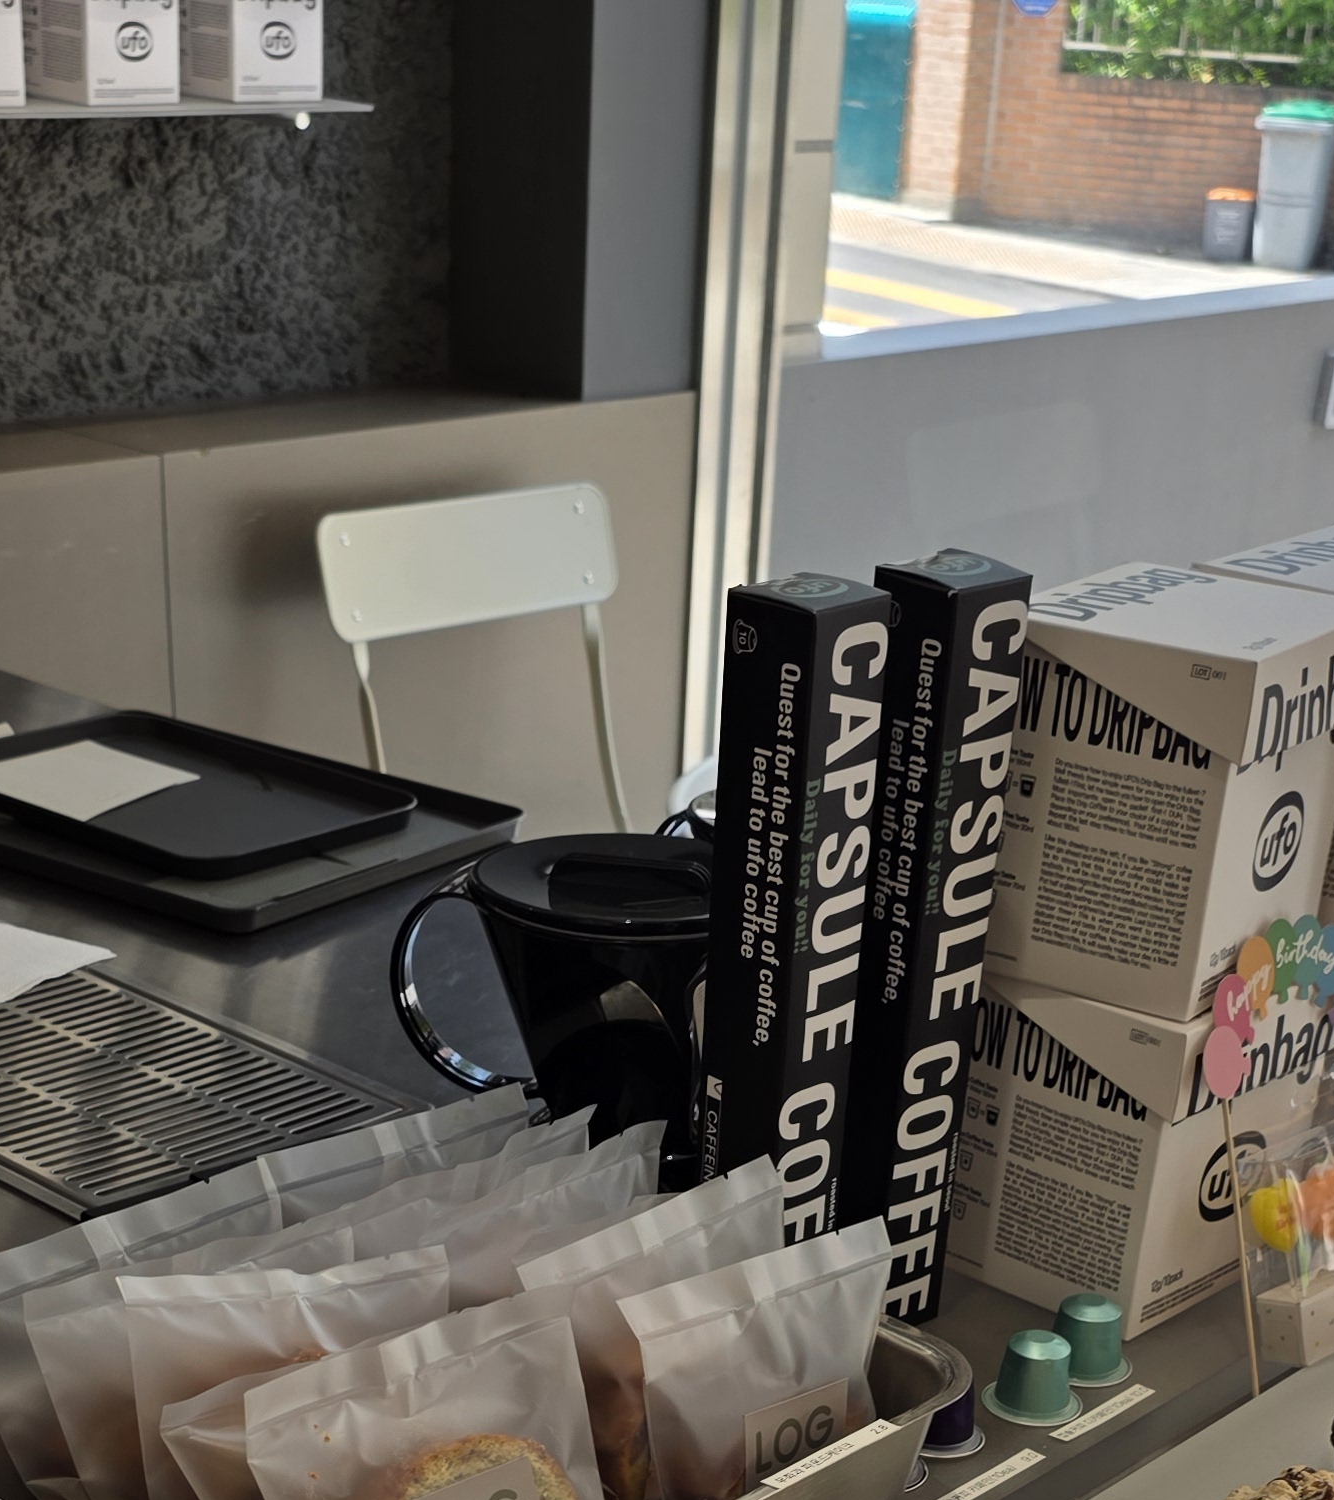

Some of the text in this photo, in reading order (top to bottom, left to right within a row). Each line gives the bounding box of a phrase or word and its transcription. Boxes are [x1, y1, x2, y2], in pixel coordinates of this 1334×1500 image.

[122, 33, 149, 52] ufo
[265, 32, 291, 51] ufo
[916, 638, 942, 711] Quest
[1052, 662, 1088, 742] TO
[912, 715, 933, 749] for
[907, 751, 928, 793] the
[873, 719, 909, 920] lead to ufo coffee
[902, 798, 924, 851] best
[930, 599, 1028, 1020] CAPSULE
[1260, 811, 1297, 864] ufo
[740, 747, 772, 960] lead to ufo coffee
[753, 662, 801, 1047] Quest for the best cup of coffee,
[894, 854, 913, 898] cup
[777, 620, 889, 1243] CAPSULE COF
[891, 903, 910, 932] of
[1227, 962, 1272, 1021] happy
[885, 1040, 960, 1318] COFFEE
[755, 1404, 835, 1475] LOG
